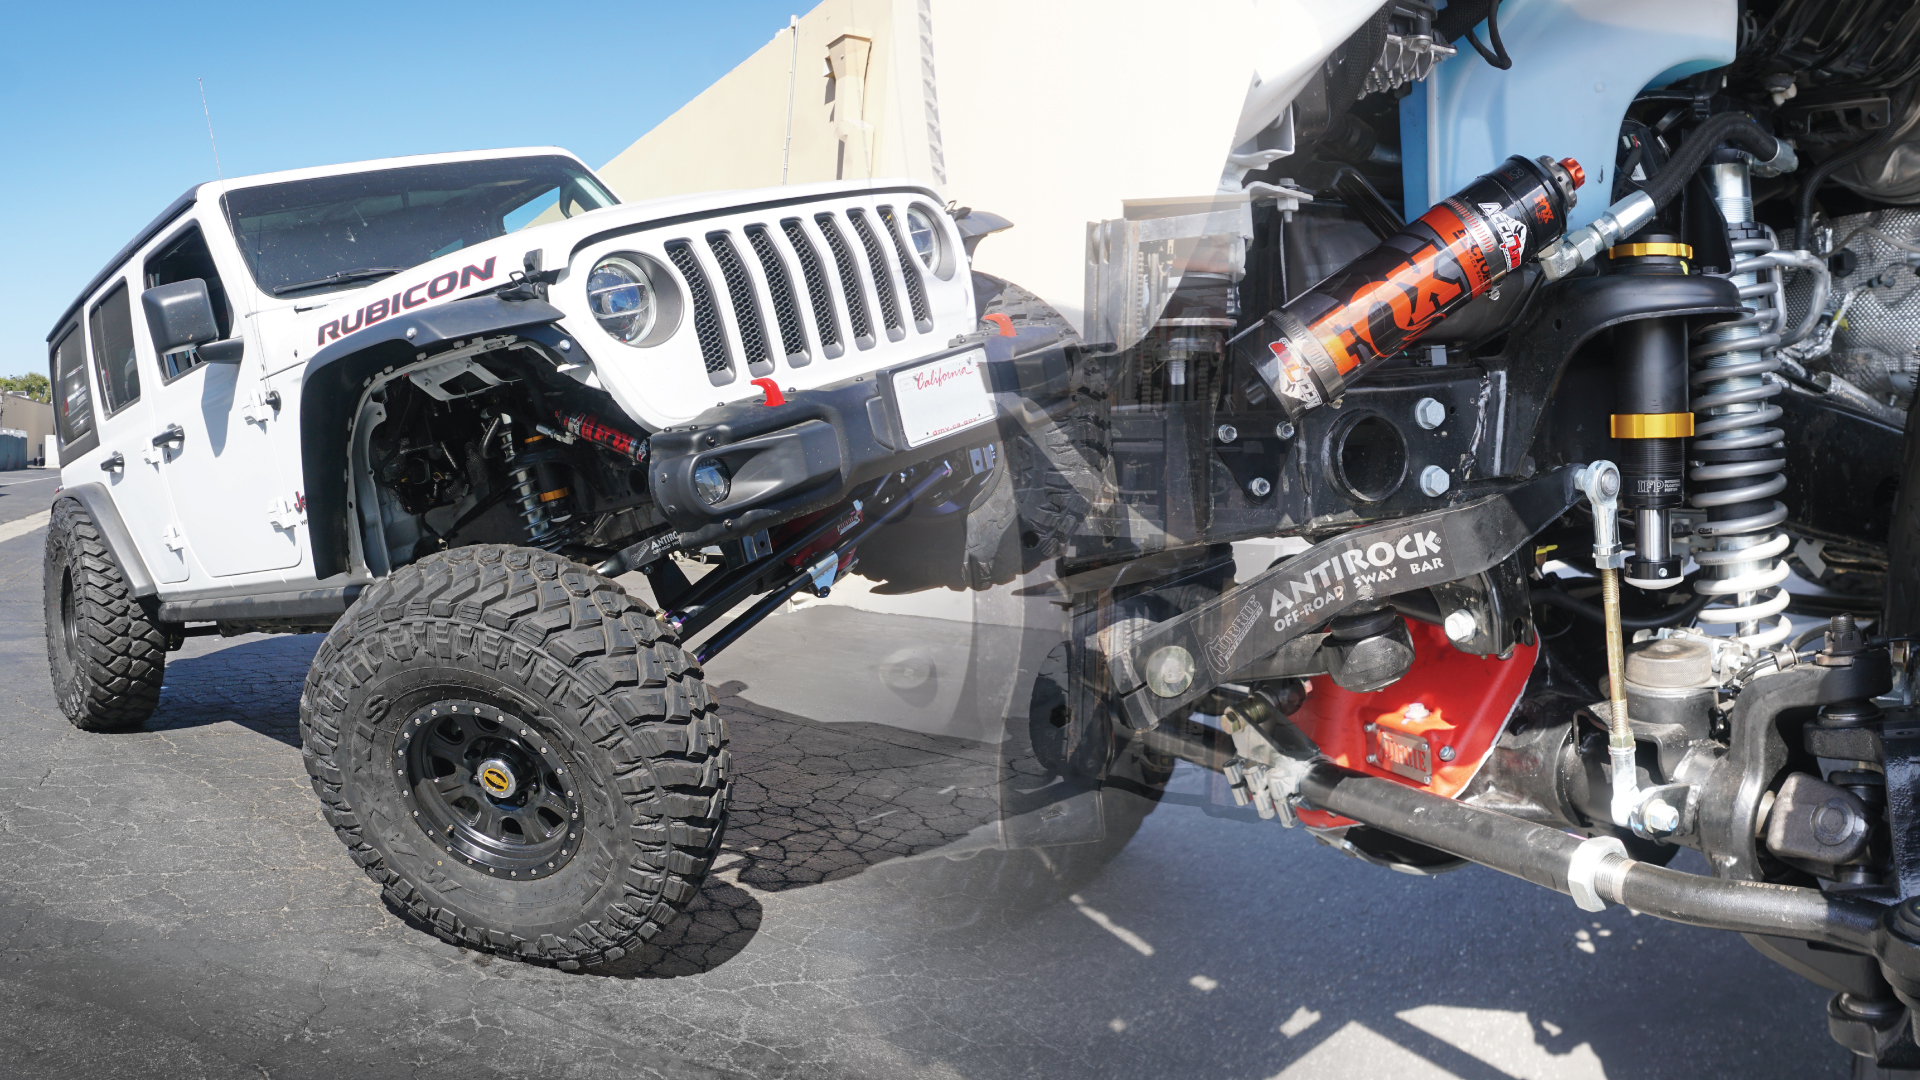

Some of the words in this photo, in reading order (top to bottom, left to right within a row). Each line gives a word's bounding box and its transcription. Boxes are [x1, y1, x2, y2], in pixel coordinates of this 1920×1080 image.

[318, 255, 497, 346] RUBICON
[1307, 243, 1462, 374] FOX
[917, 366, 973, 390] California
[932, 417, 977, 436] dmv.ca.gov
[1638, 480, 1664, 492] IFP
[1270, 530, 1442, 617] ANTIROCK
[1273, 585, 1344, 632] OFF-ROAD
[1353, 566, 1397, 588] SWAY
[1410, 557, 1444, 575] BAR
[1203, 594, 1260, 675] CURRIE
